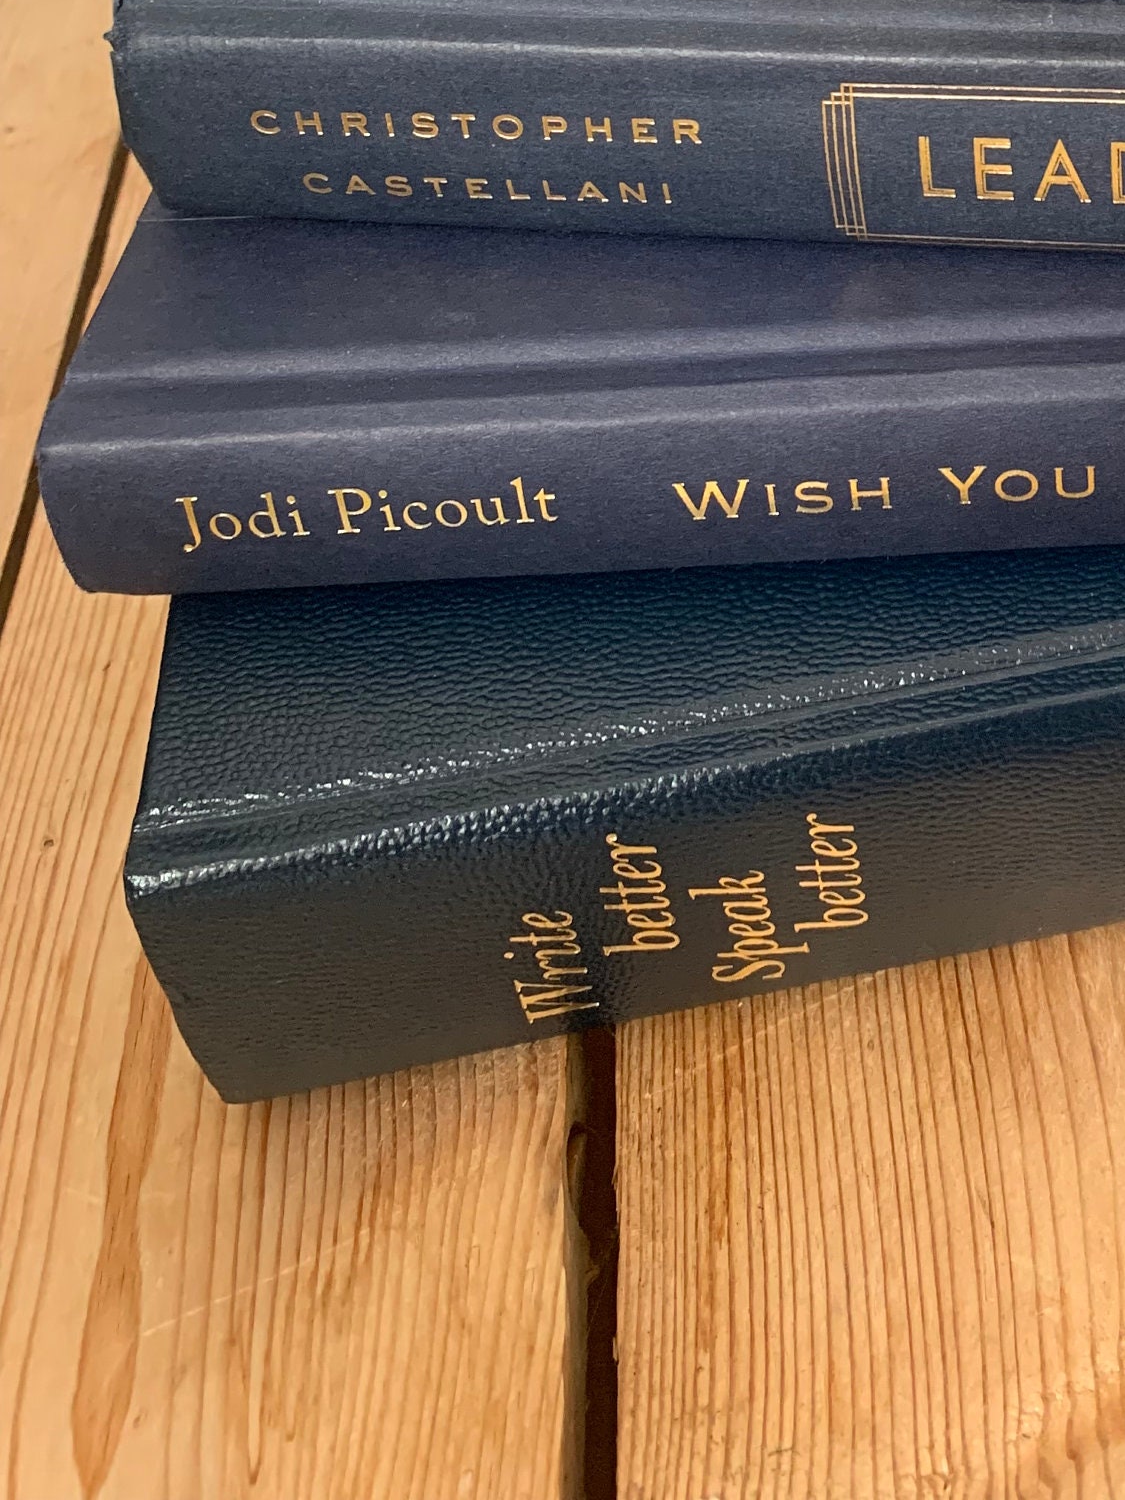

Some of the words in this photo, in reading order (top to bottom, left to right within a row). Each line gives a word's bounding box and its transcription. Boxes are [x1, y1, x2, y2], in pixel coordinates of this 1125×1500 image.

[249, 108, 703, 145] CHRISTOPHER
[301, 171, 673, 205] CASTELLANI
[174, 491, 311, 555] Jodi
[326, 476, 560, 536] Picoult
[670, 475, 894, 522] WISH
[937, 464, 1098, 505] YOU
[598, 831, 682, 958] better
[792, 811, 870, 934] better
[503, 908, 600, 1026] Write
[686, 868, 811, 984] Speak
